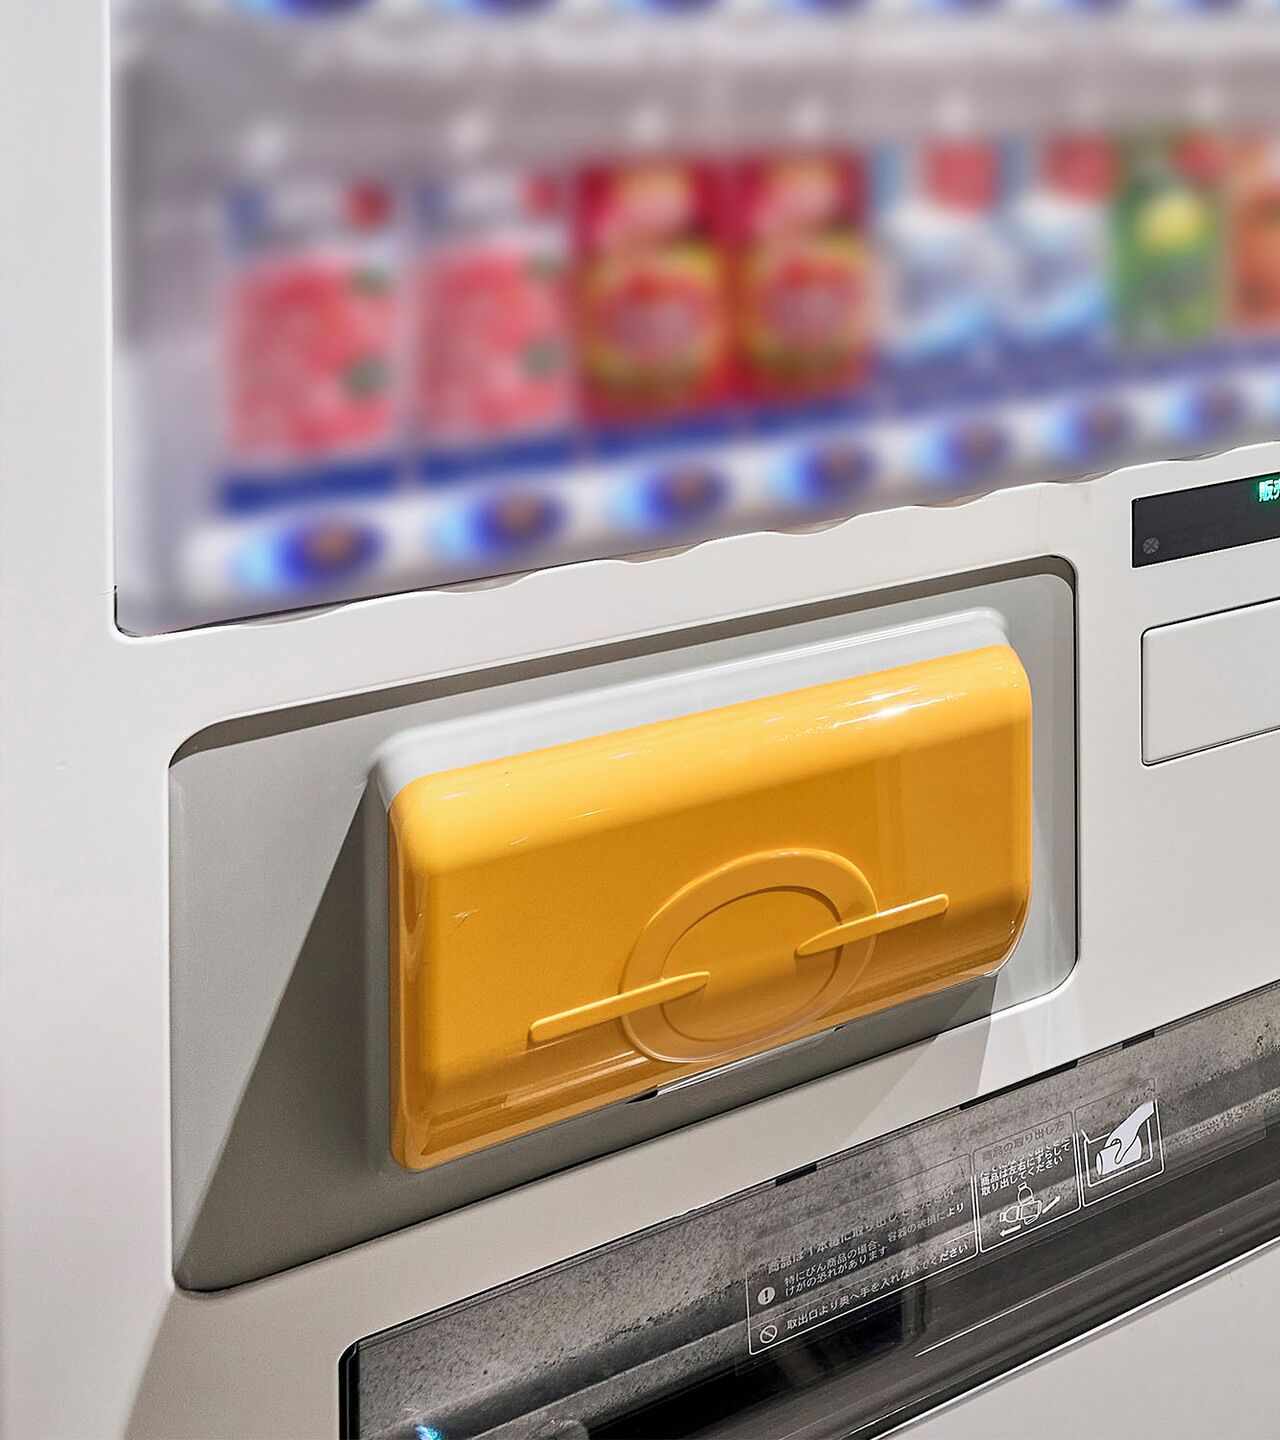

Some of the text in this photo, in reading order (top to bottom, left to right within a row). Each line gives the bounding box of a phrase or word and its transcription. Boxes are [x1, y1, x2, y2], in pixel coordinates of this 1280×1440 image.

[981, 1142, 1071, 1187] 商品は左右にずらして
[981, 1155, 1063, 1196] 取り出してください
